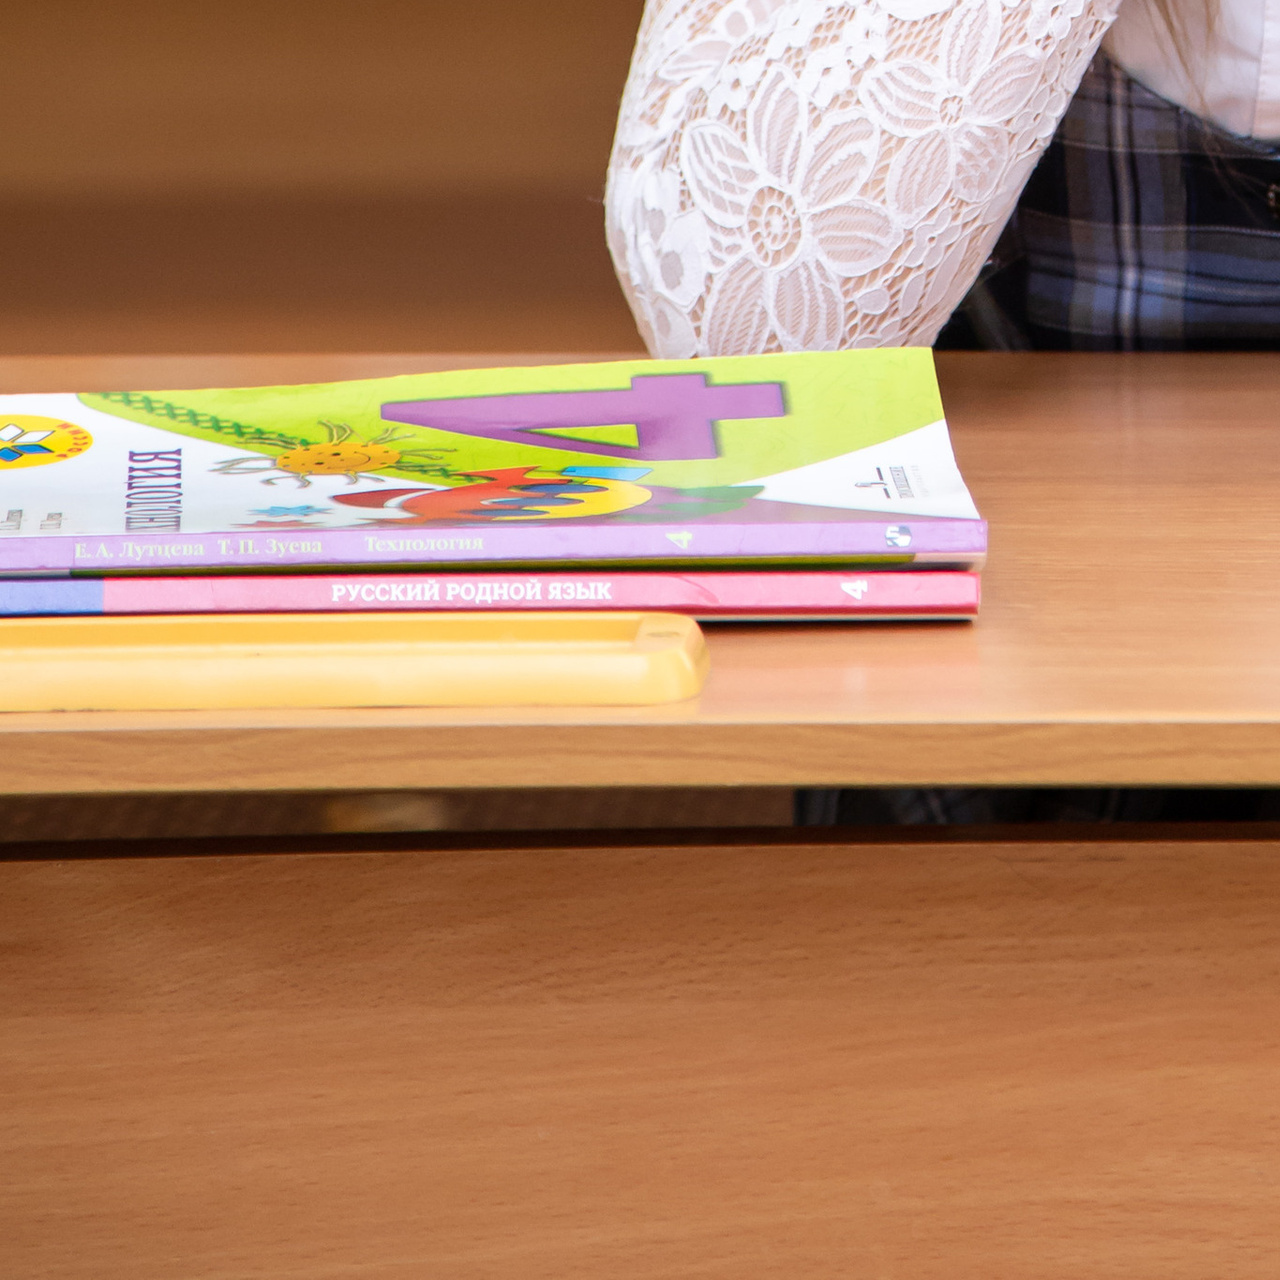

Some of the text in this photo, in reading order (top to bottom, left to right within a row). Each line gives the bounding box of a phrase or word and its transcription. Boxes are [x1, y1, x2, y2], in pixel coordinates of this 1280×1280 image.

[381, 372, 785, 459] 4
[118, 541, 205, 560] Лутцева
[266, 539, 322, 557] Зуева
[364, 536, 484, 553] Технология
[332, 579, 440, 602] РУССКИЙ
[446, 579, 542, 604] РОДНОЙ
[548, 582, 612, 601] ЯЗЫК
